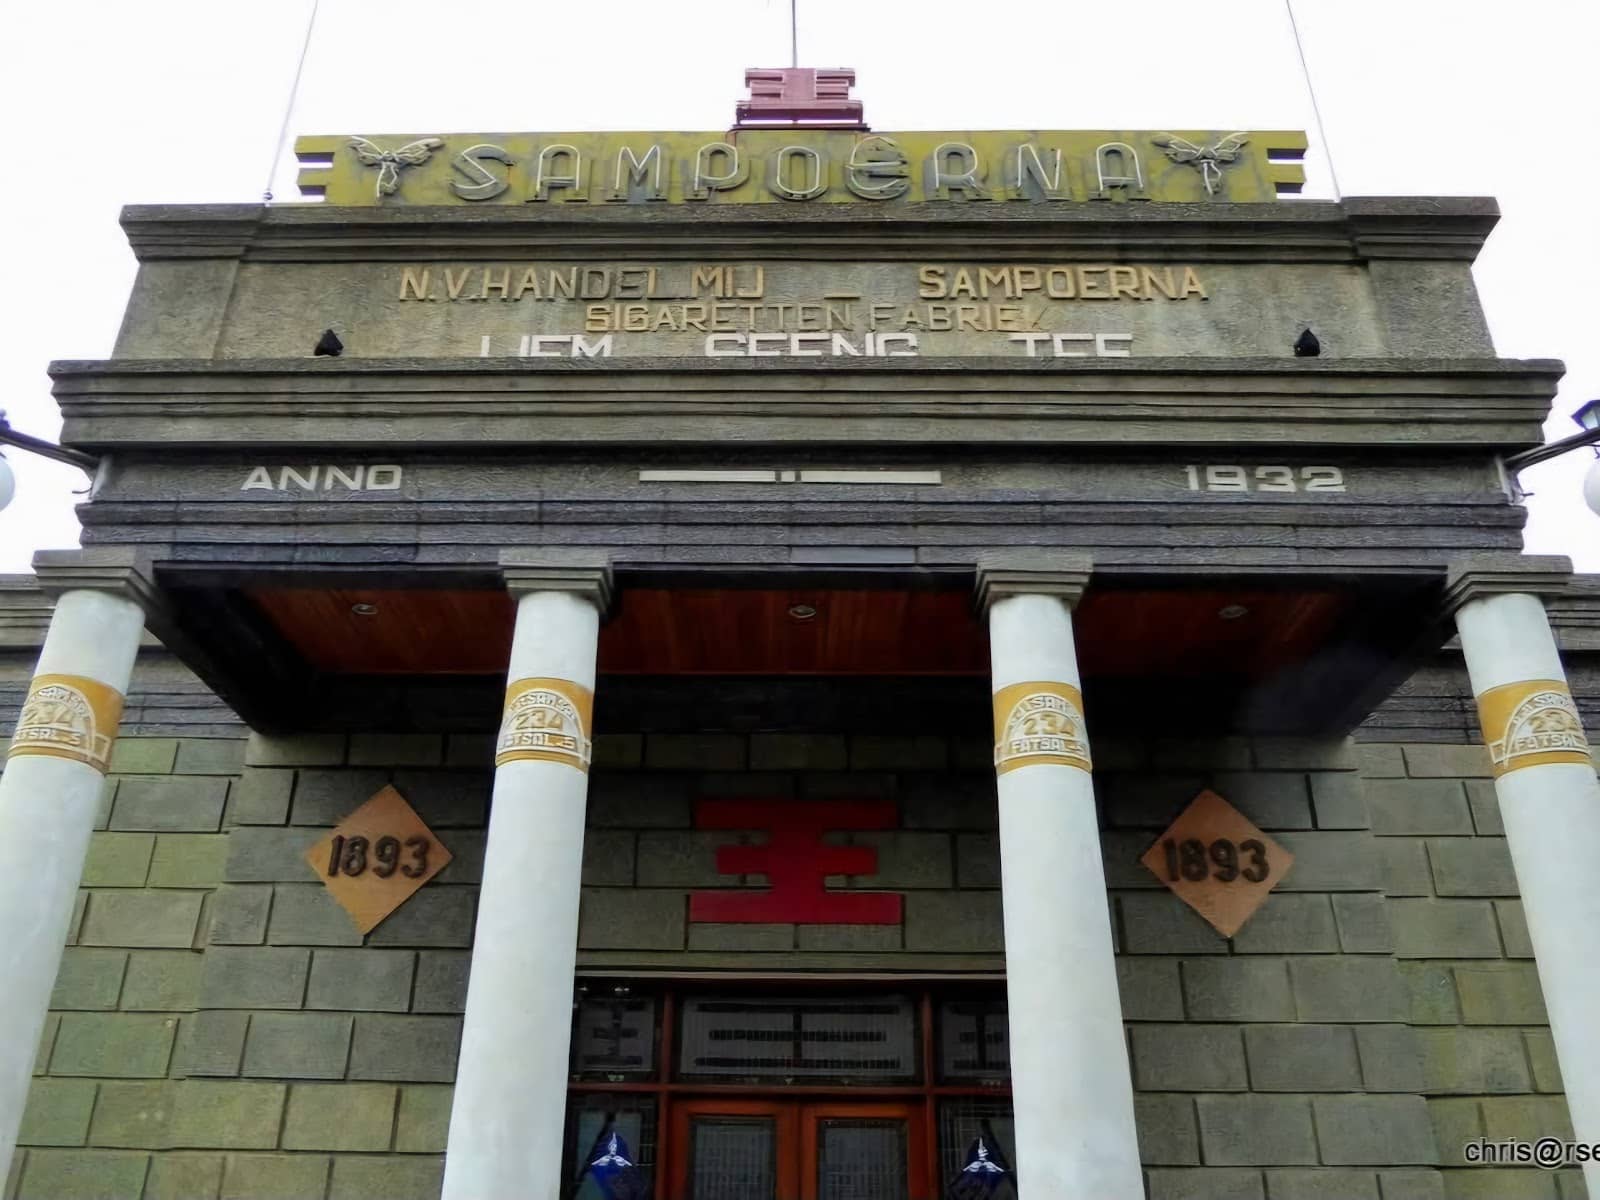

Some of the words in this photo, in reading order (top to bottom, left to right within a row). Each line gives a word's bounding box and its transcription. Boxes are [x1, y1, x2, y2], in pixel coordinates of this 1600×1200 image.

[919, 265, 1208, 300] SAMPOERNA
[584, 302, 854, 332] SIGARETTEN
[240, 464, 402, 490] ANNO
[1184, 464, 1347, 492] 1932
[327, 834, 430, 879] 1893
[1162, 838, 1270, 883] 1893
